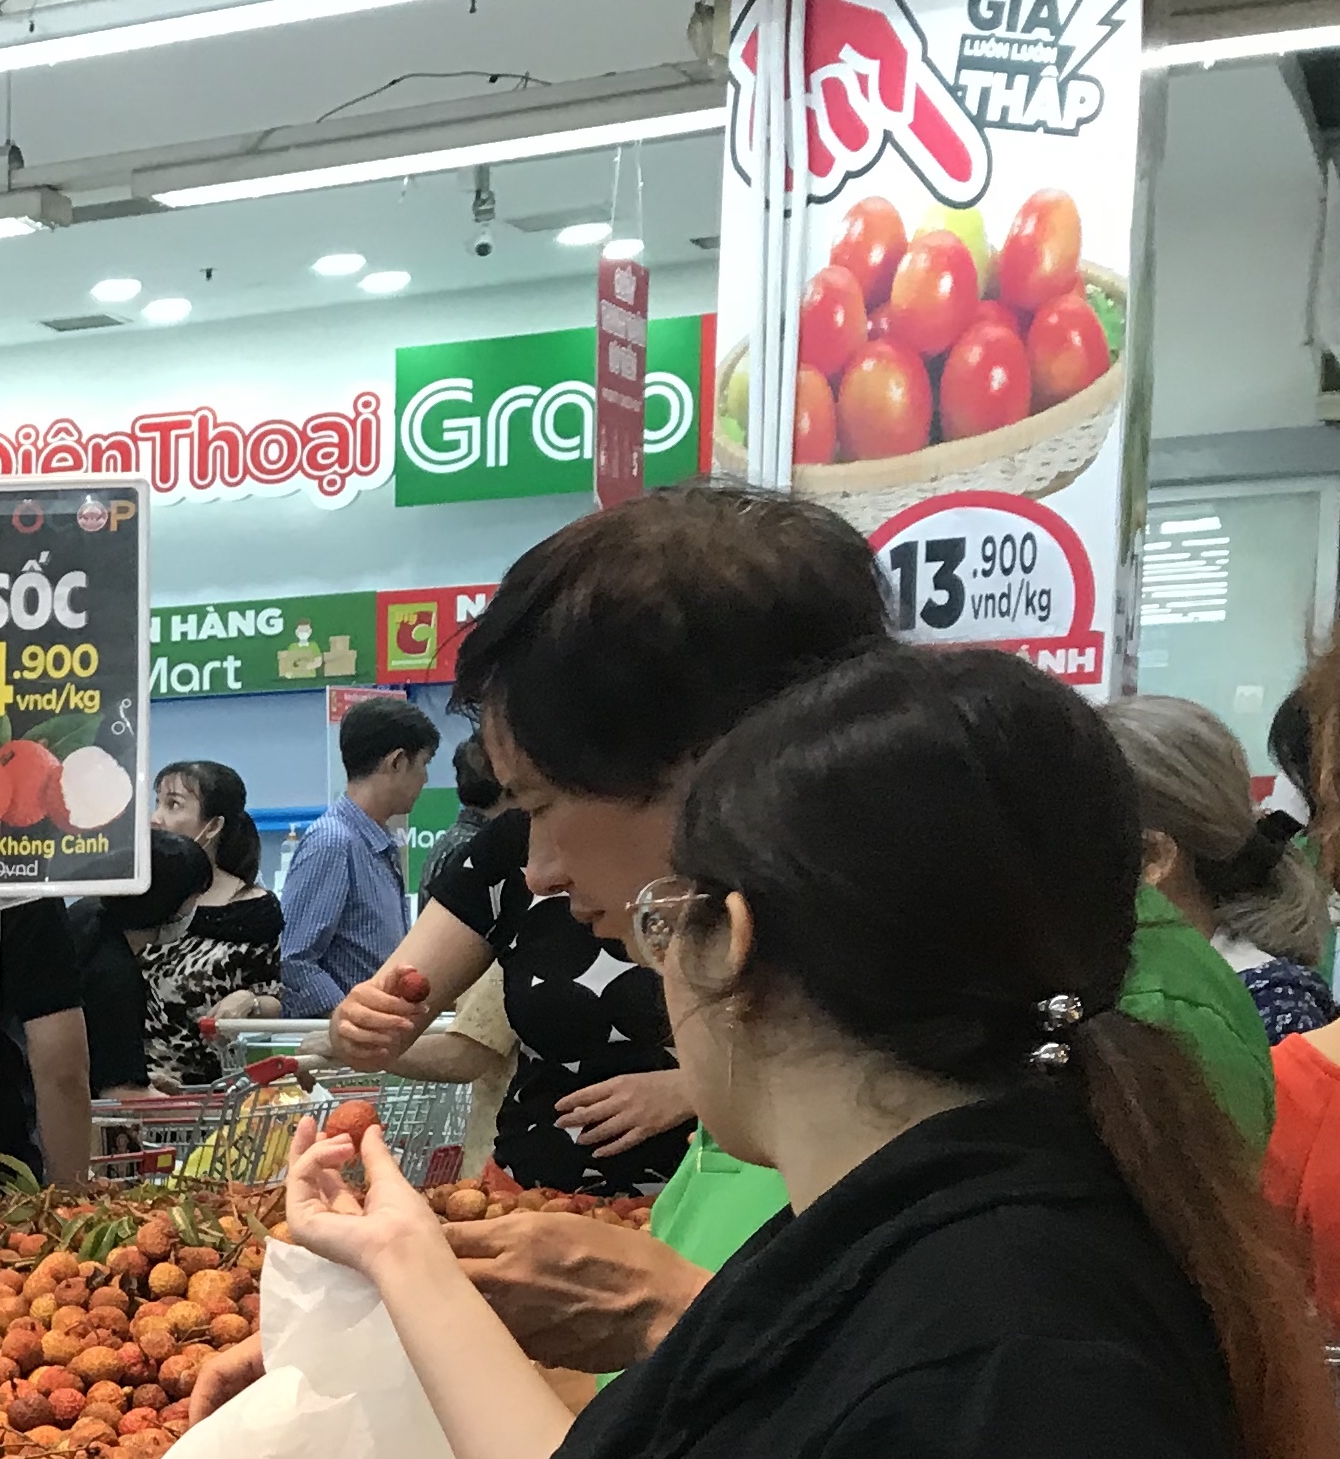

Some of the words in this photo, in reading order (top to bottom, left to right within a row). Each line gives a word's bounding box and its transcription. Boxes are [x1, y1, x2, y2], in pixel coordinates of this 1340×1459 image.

[132, 392, 380, 496] Thoại
[971, 578, 1052, 622] vnd/kg
[171, 607, 284, 642] HÀNG
[15, 683, 101, 713] vnd/kg
